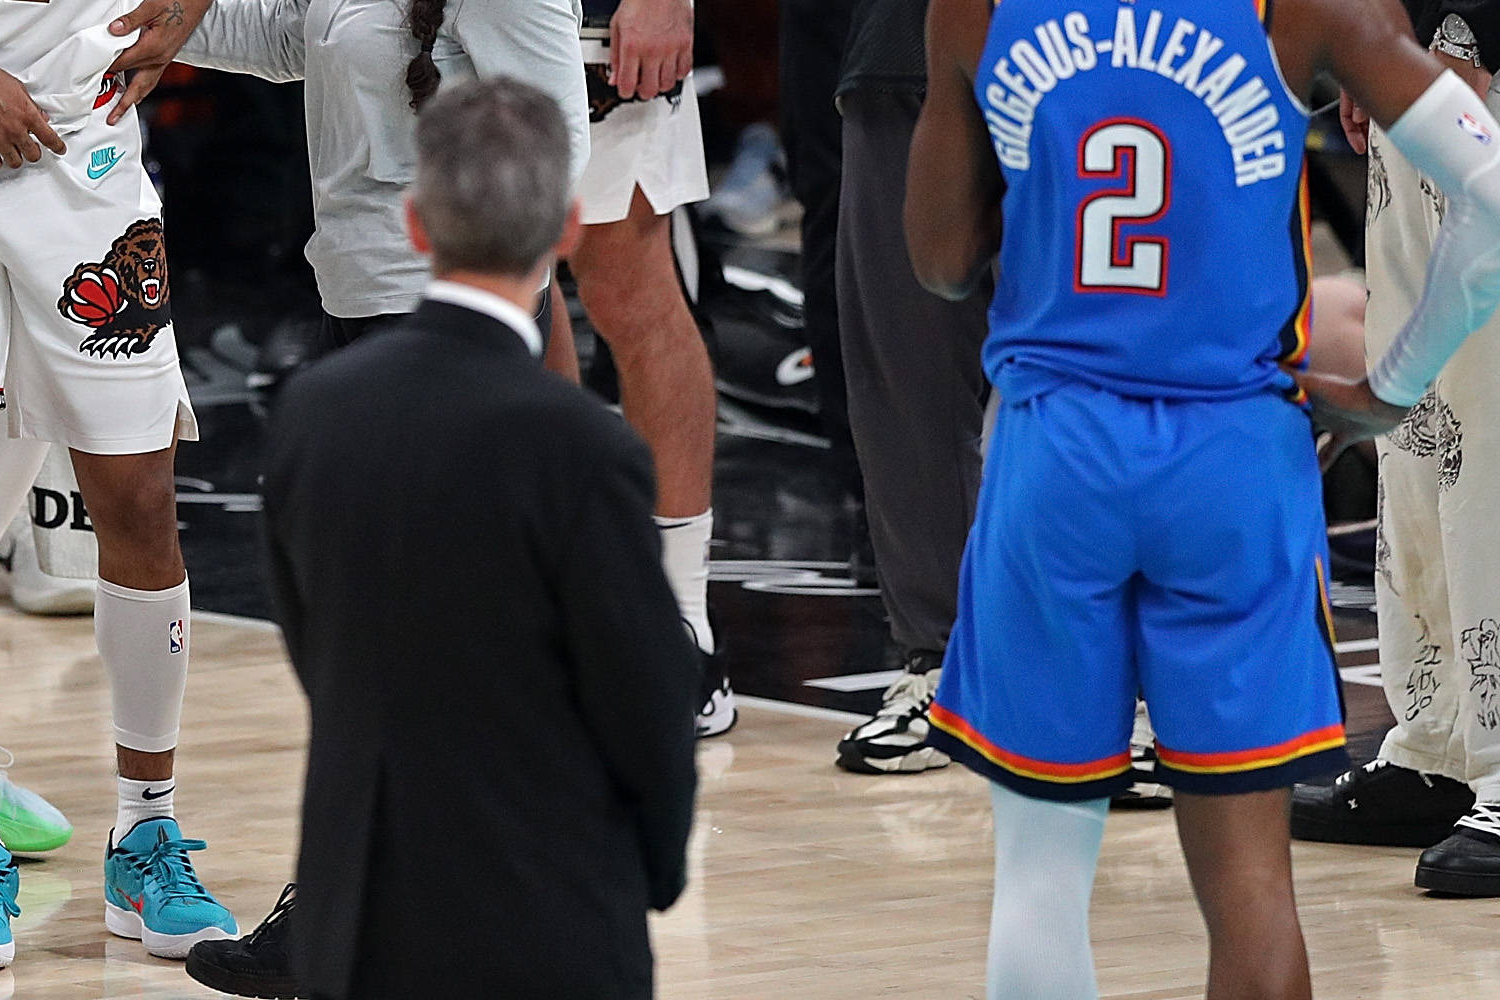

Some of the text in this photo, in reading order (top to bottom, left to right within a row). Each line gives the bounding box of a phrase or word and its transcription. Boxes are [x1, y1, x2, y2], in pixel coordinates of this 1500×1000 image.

[91, 145, 117, 167] NIKE
[985, 6, 1286, 187] GILGEOUS-ALEXANDER
[1073, 116, 1172, 297] 2
